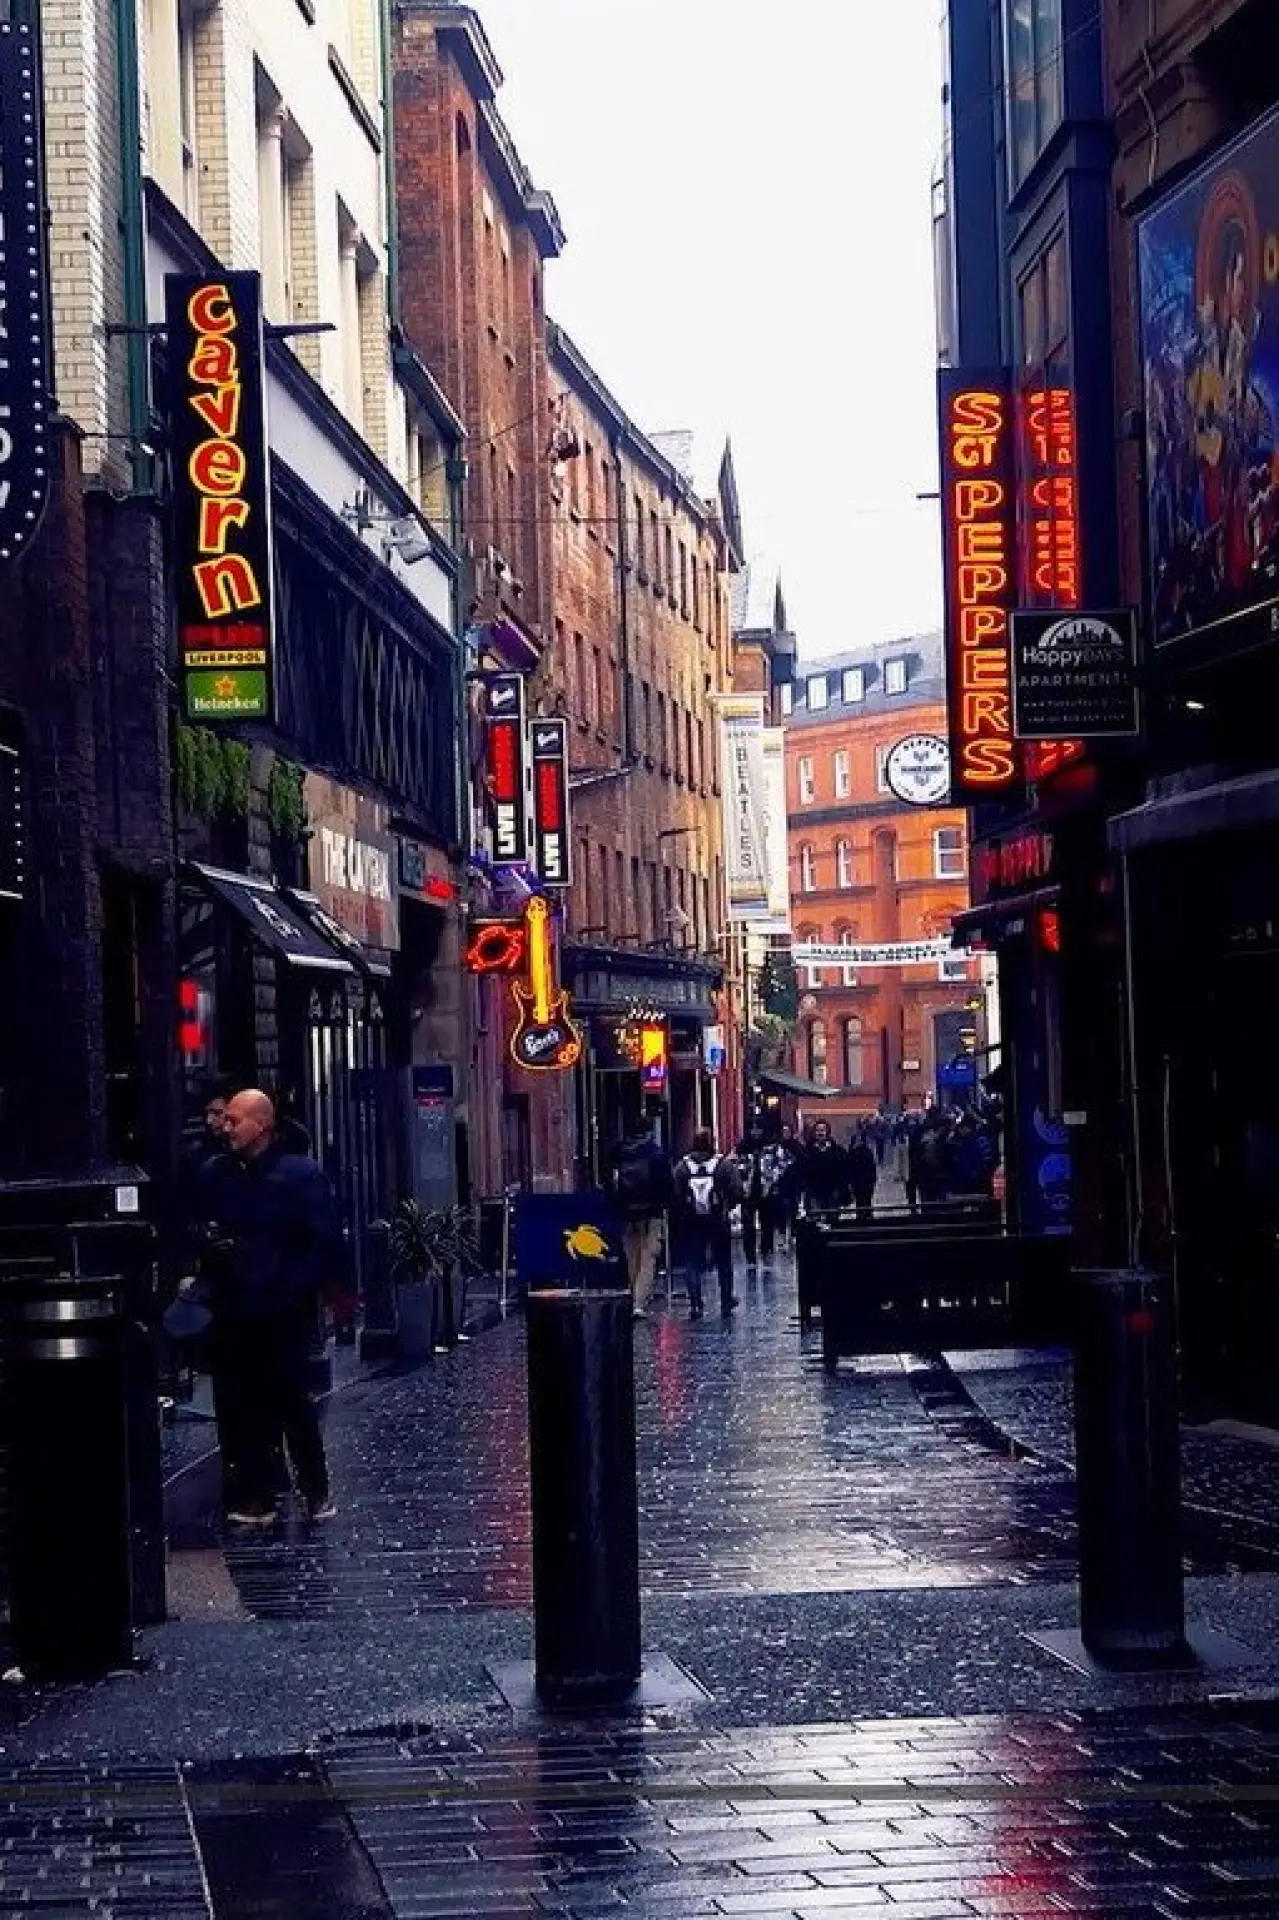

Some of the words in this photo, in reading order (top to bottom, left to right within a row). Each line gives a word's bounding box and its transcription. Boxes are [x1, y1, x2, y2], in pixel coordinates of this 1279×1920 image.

[188, 285, 260, 618] cavern
[954, 478, 1015, 783] PEPPERS
[735, 747, 752, 870] BEATLES
